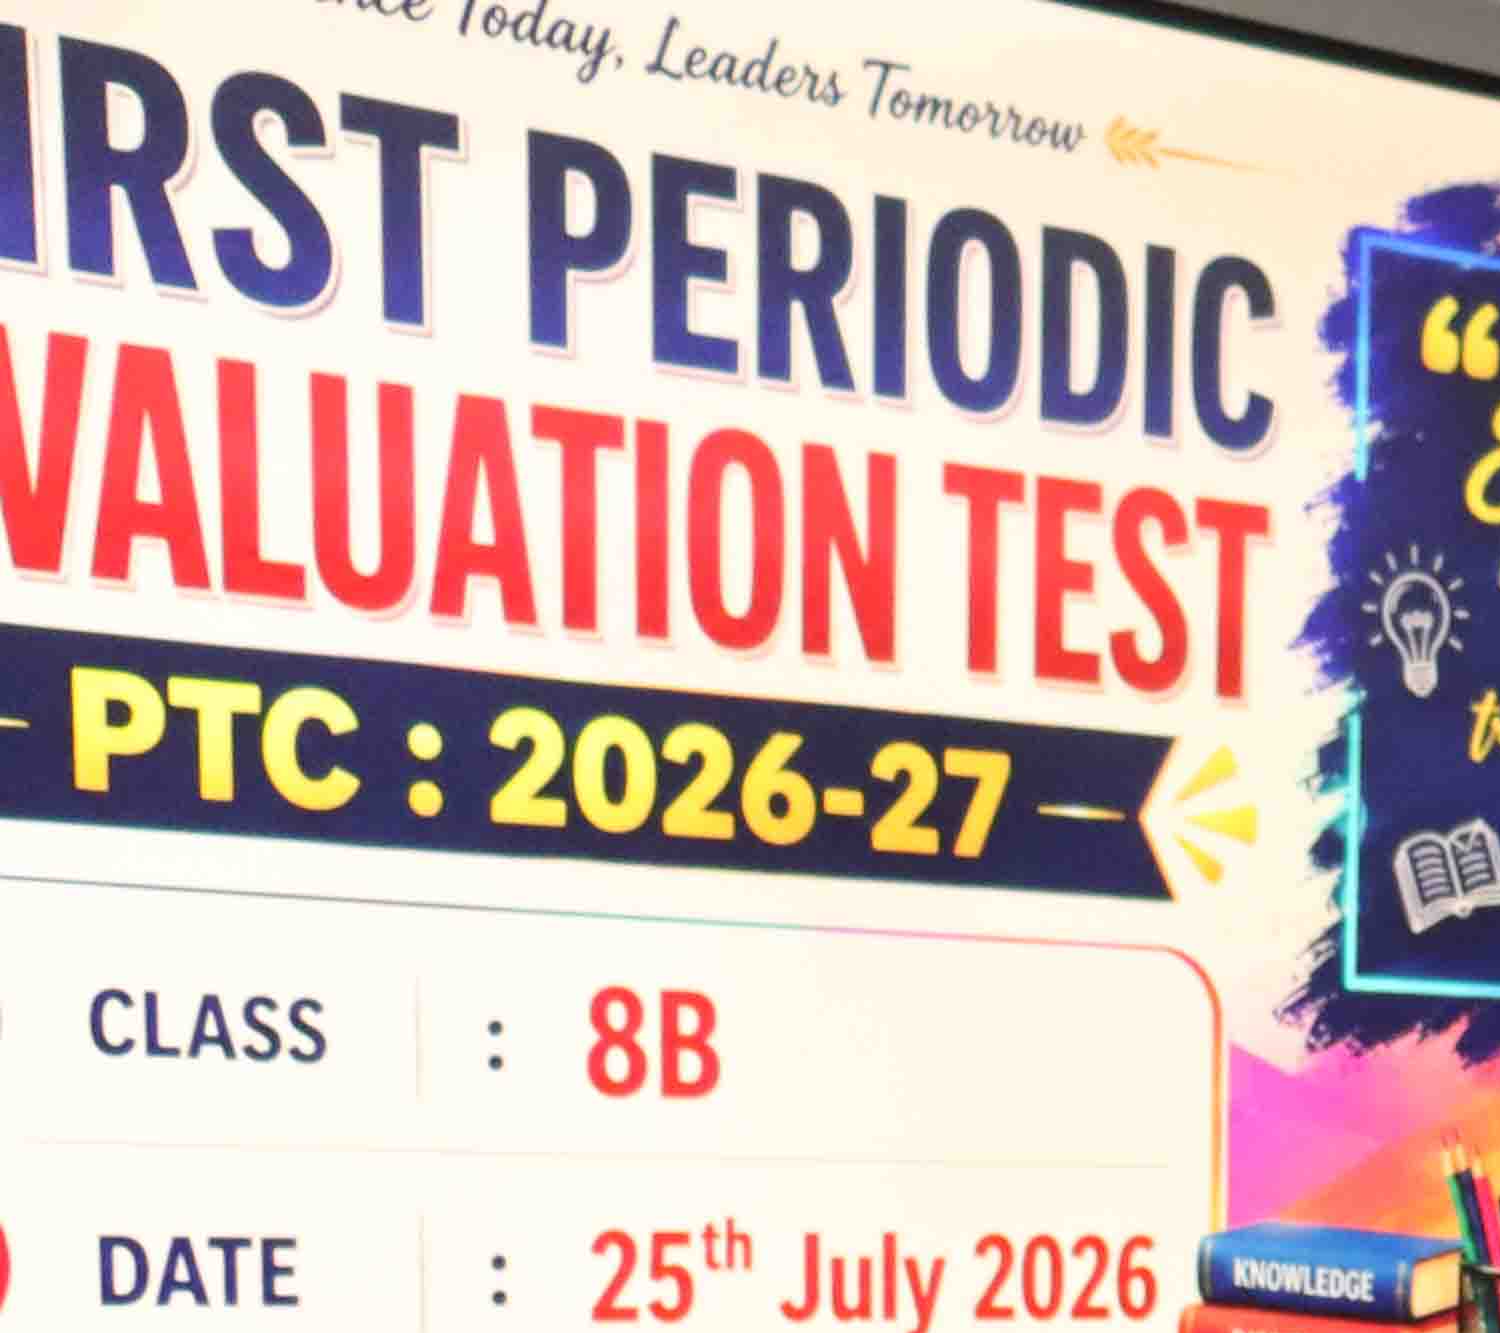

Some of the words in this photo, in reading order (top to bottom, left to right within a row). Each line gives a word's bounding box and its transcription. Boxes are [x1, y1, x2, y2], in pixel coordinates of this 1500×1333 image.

[645, 17, 848, 112] Leaders
[862, 60, 1086, 154] Tomorrow
[0, 21, 460, 326] IRST
[528, 129, 1276, 451] PERIODIC
[0, 322, 897, 666] VALUATION
[943, 463, 1270, 698] TEST
[69, 667, 361, 812] PTC
[489, 705, 1010, 859] 2026-27
[87, 990, 328, 1064] CLASS
[585, 985, 722, 1102] 8B
[98, 1234, 301, 1308] DATE
[591, 1217, 752, 1324] 25th
[973, 1234, 1157, 1323] 2026
[1234, 1258, 1374, 1302] KNOWLEDGE
